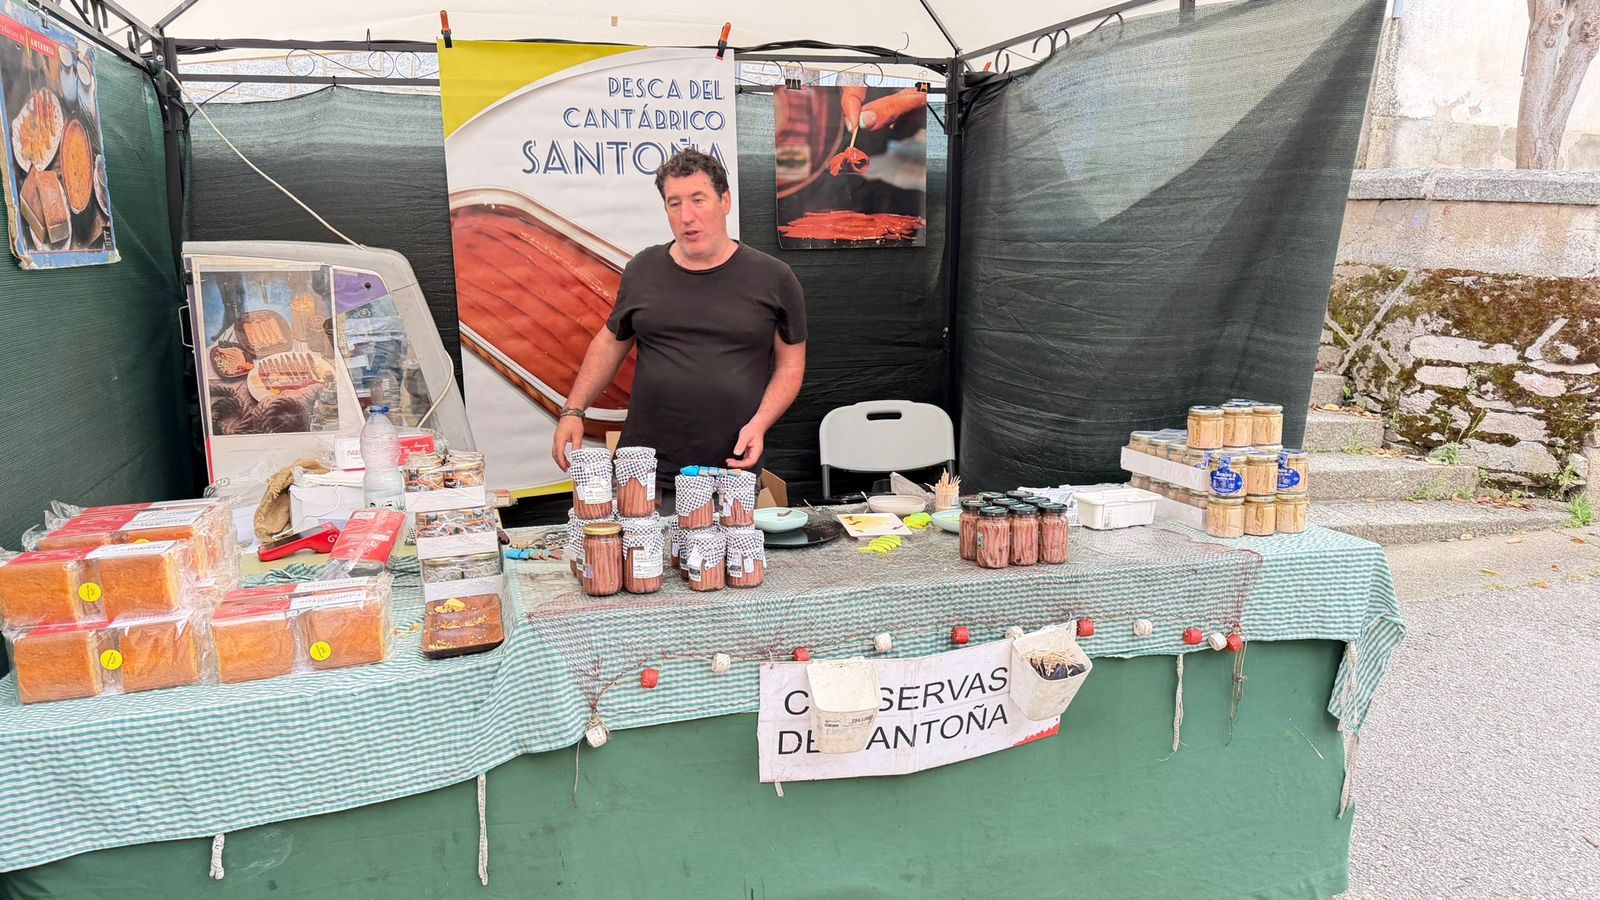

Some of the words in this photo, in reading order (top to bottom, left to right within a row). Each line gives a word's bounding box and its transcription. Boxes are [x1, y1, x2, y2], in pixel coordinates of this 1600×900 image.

[608, 76, 683, 100] PESCA
[689, 79, 725, 100] DEL
[563, 103, 726, 131] CANTÁBRICO
[784, 666, 1008, 715] CSERVAS
[865, 703, 1008, 751] ANTOÑA
